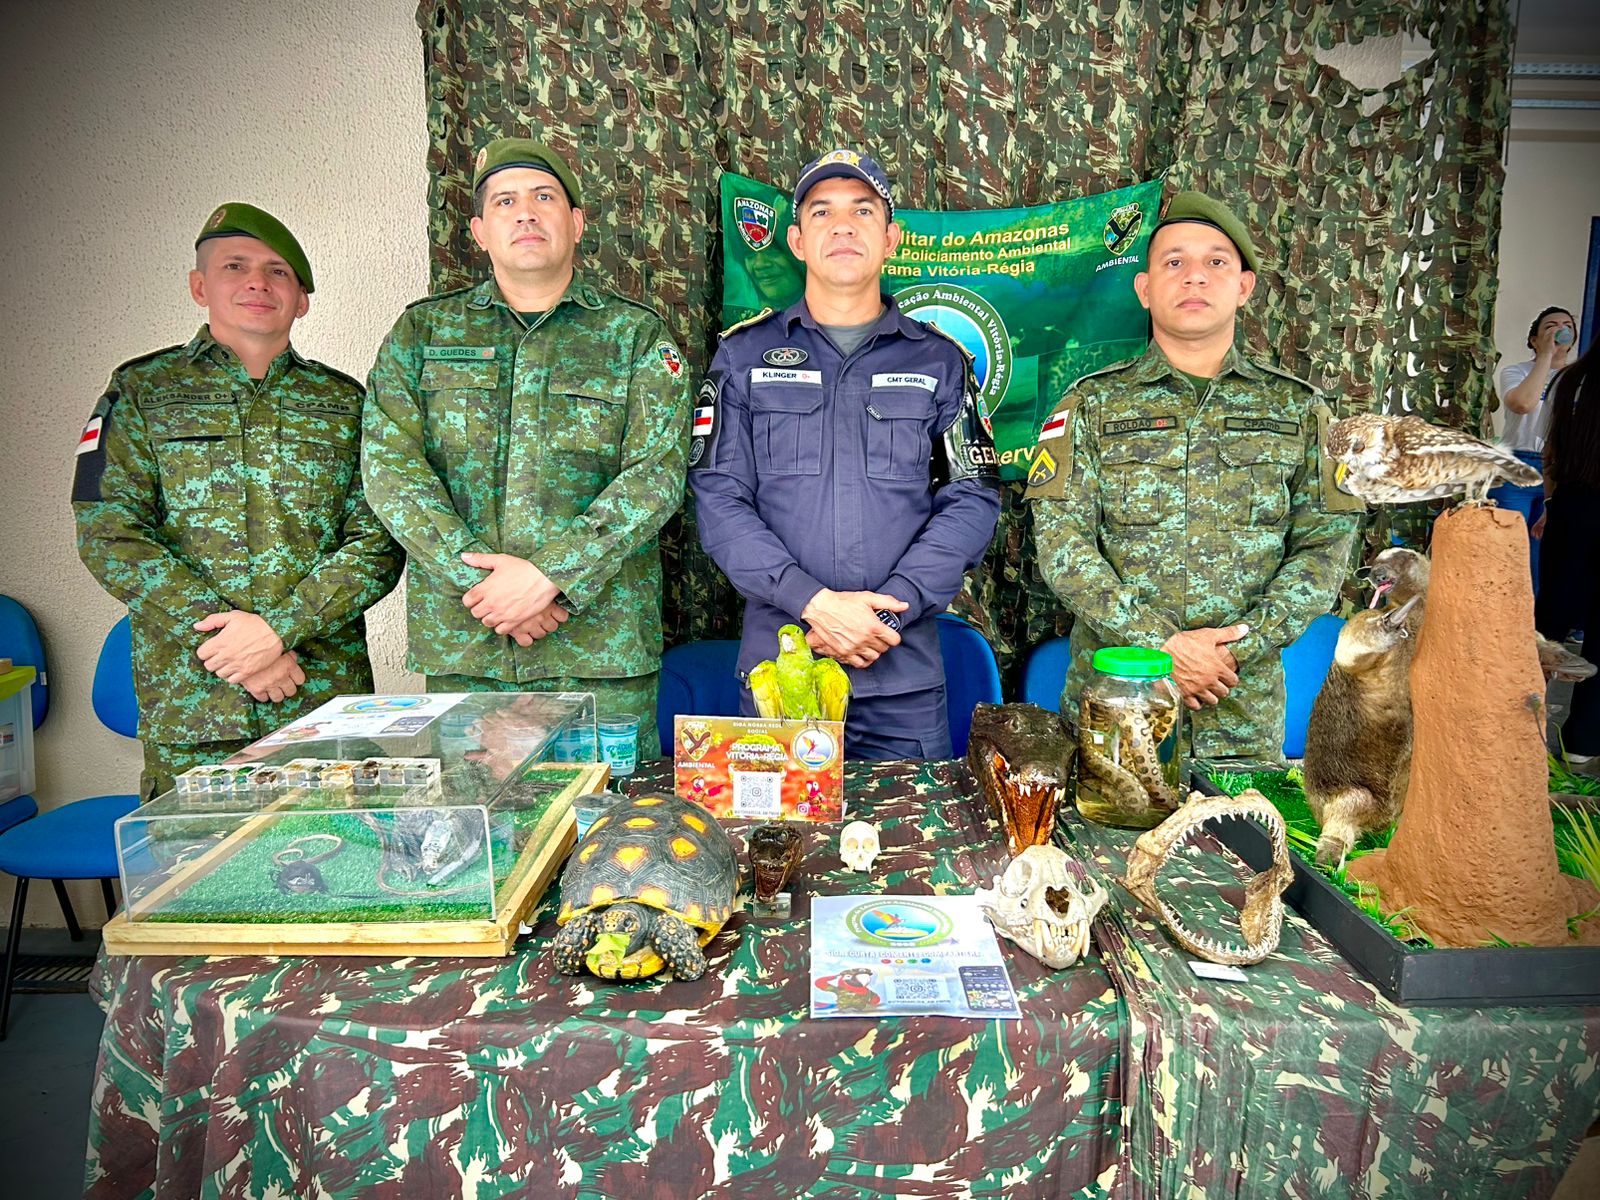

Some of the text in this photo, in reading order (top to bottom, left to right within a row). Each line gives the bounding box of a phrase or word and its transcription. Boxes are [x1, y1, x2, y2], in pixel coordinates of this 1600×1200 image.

[737, 199, 774, 217] AMAZONAS
[900, 223, 1070, 247] litar do Amazonas
[901, 247, 994, 262] Policiamento
[997, 237, 1071, 259] Ambiental
[881, 259, 1035, 277] rama Vitória-Régia
[1095, 255, 1140, 273] AMBIENTAL
[897, 291, 930, 309] cação
[932, 289, 990, 321] Ambiental
[428, 349, 438, 357] D.
[440, 349, 477, 357] GUEDES
[762, 371, 797, 379] KLINGER
[905, 376, 927, 386] GERAL
[143, 393, 212, 404] ALEKSANDER
[1243, 420, 1280, 430] CPAmb
[731, 743, 781, 753] PROGRAMA
[677, 761, 716, 769] AMBIENTAL
